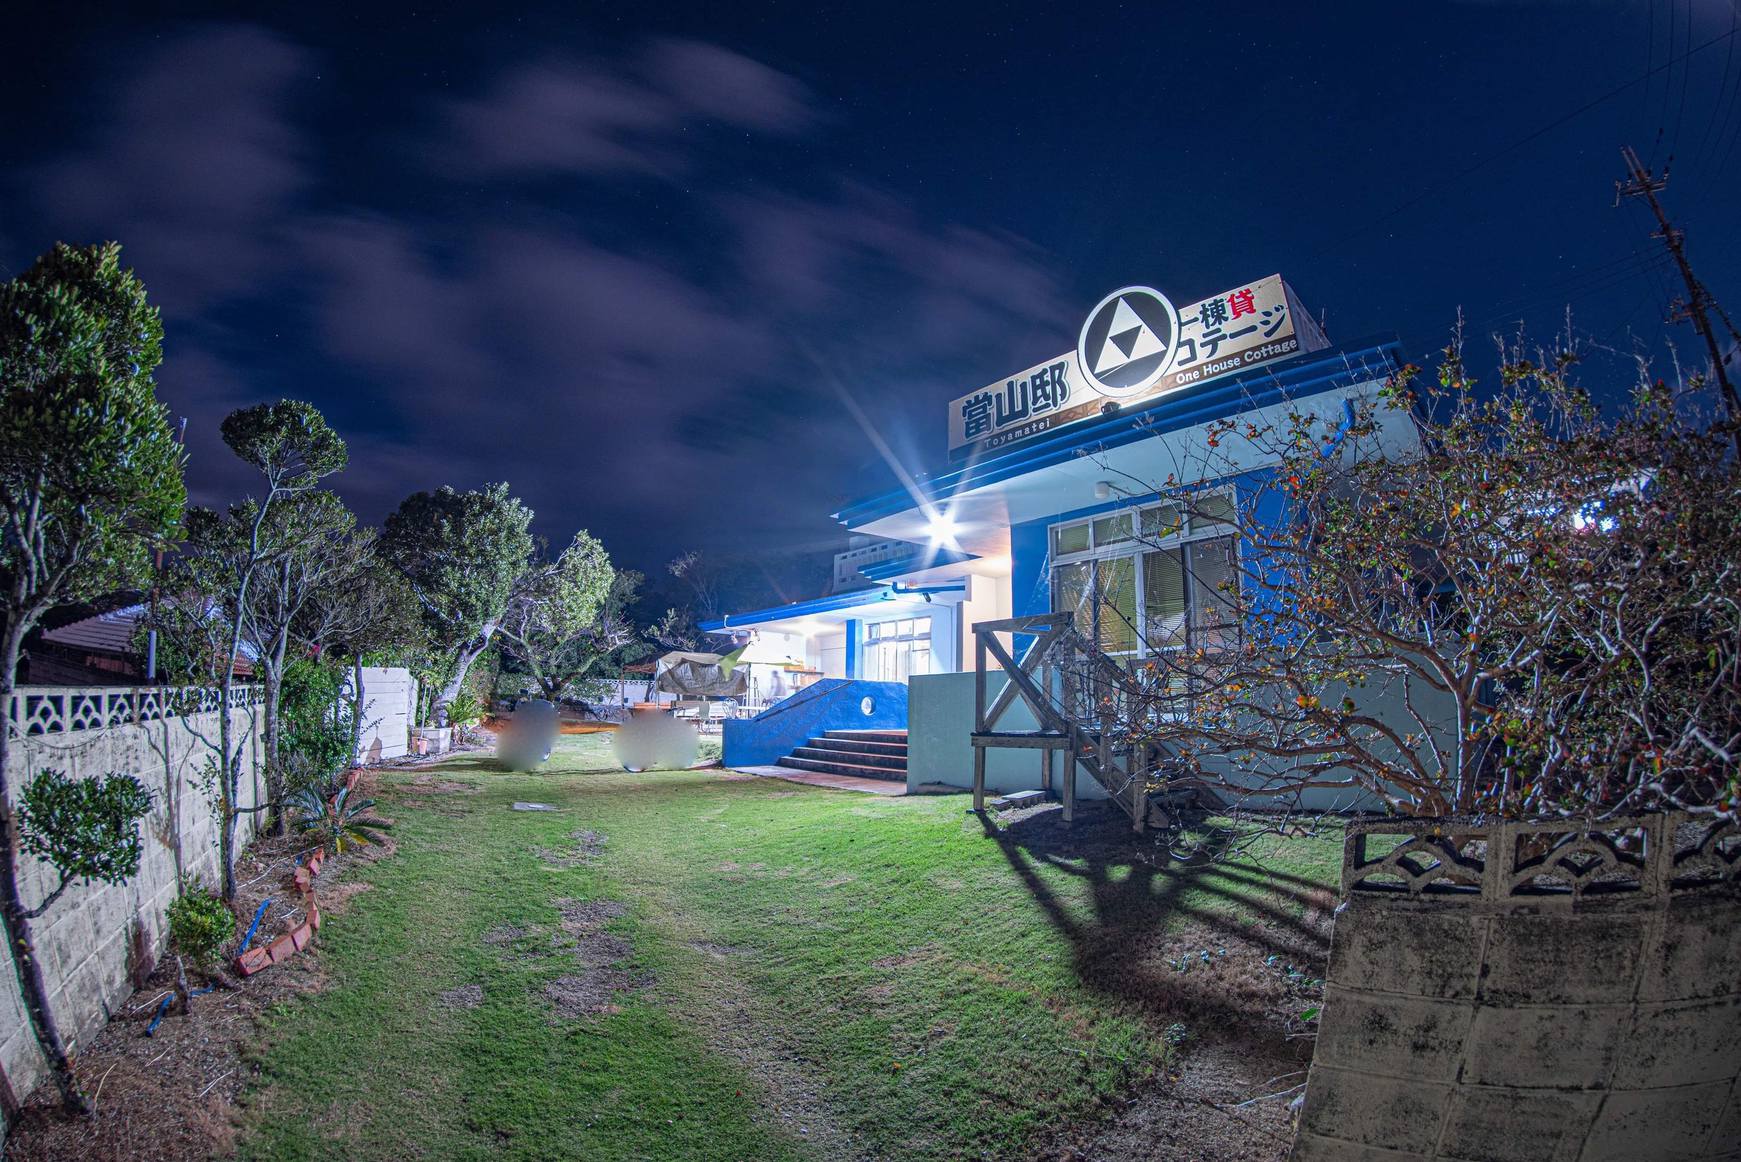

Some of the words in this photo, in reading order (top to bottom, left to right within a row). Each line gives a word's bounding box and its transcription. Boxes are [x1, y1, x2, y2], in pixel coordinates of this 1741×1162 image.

[1180, 288, 1257, 329] 一棟貸
[1177, 304, 1286, 367] コテージ
[1176, 369, 1200, 384] One
[1203, 356, 1241, 376] House
[1244, 339, 1298, 362] Cottage
[962, 361, 1069, 440] 當山邸
[984, 417, 1050, 448] Toyamatei
